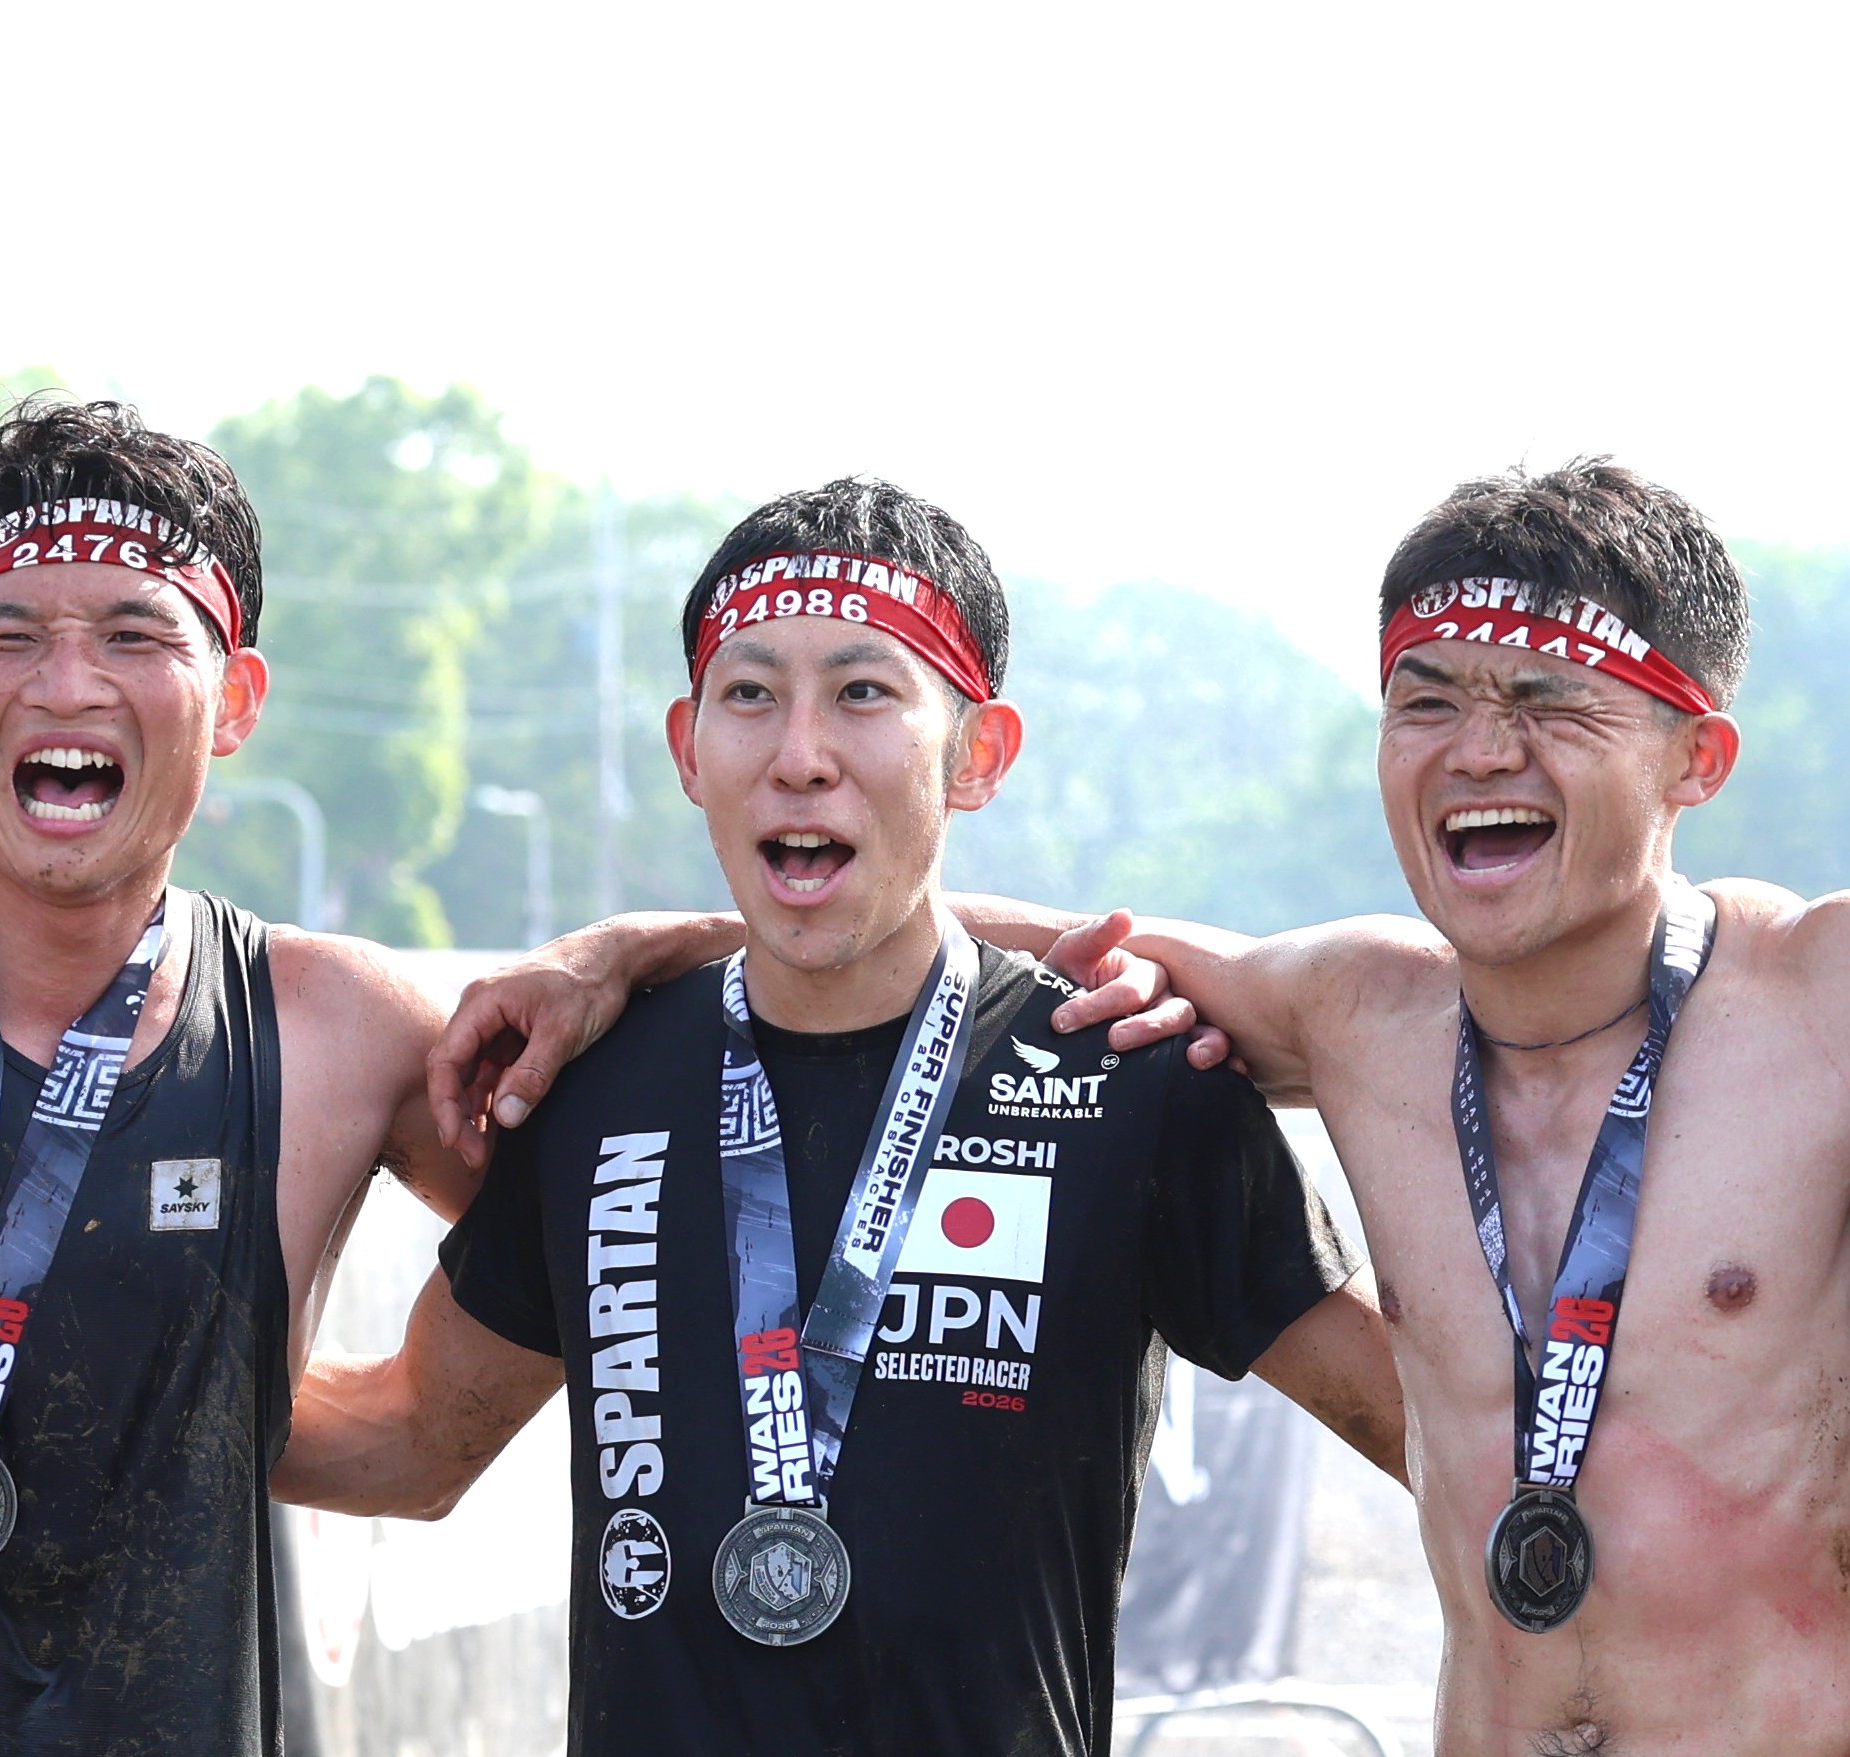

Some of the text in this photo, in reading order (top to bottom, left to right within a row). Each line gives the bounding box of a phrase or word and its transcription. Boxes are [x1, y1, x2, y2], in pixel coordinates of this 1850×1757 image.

[740, 554, 920, 605] SPARTAN
[719, 588, 868, 641] 24986
[1461, 577, 1651, 662] SPARTAN
[861, 972, 967, 1254] SUPER FINISHER
[988, 1104, 1104, 1119] UNBREAKABLE
[851, 1091, 911, 1249] OBSTACLES
[160, 1201, 210, 1214] SAYSKY
[588, 1130, 670, 1499] SPARTAN
[877, 1284, 1042, 1354] JPN
[739, 1326, 801, 1376] 26
[875, 1352, 1031, 1391] SELECTED RACER
[961, 1390, 1026, 1412] 2026
